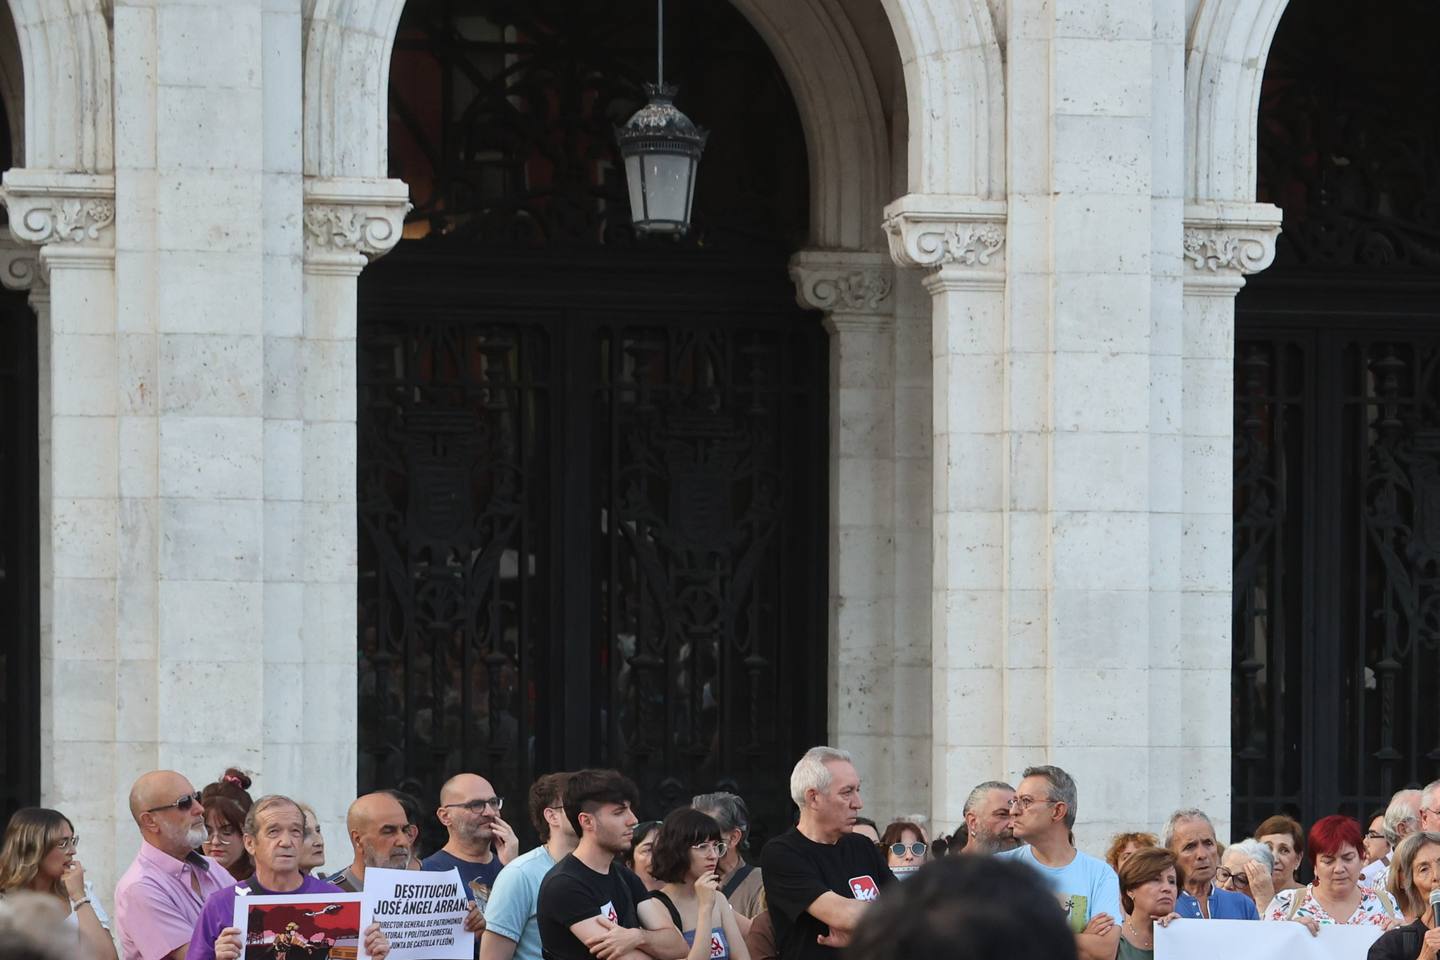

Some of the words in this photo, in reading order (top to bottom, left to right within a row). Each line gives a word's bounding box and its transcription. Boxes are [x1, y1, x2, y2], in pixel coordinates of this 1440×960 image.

[394, 883, 458, 899] DESTITUCION
[373, 898, 401, 915] JOSÉ
[402, 898, 432, 915] ÁNGEL
[404, 919, 426, 928] GENERAL
[426, 919, 433, 928] DE
[433, 917, 463, 926] PATRIMONIO
[384, 930, 403, 939] ATURAL
[408, 929, 430, 938] POLÍTICA
[430, 927, 453, 937] FORESTAL
[406, 940, 413, 949] DE
[413, 939, 435, 948] CASTILLA
[439, 937, 454, 947] LEÓN)
